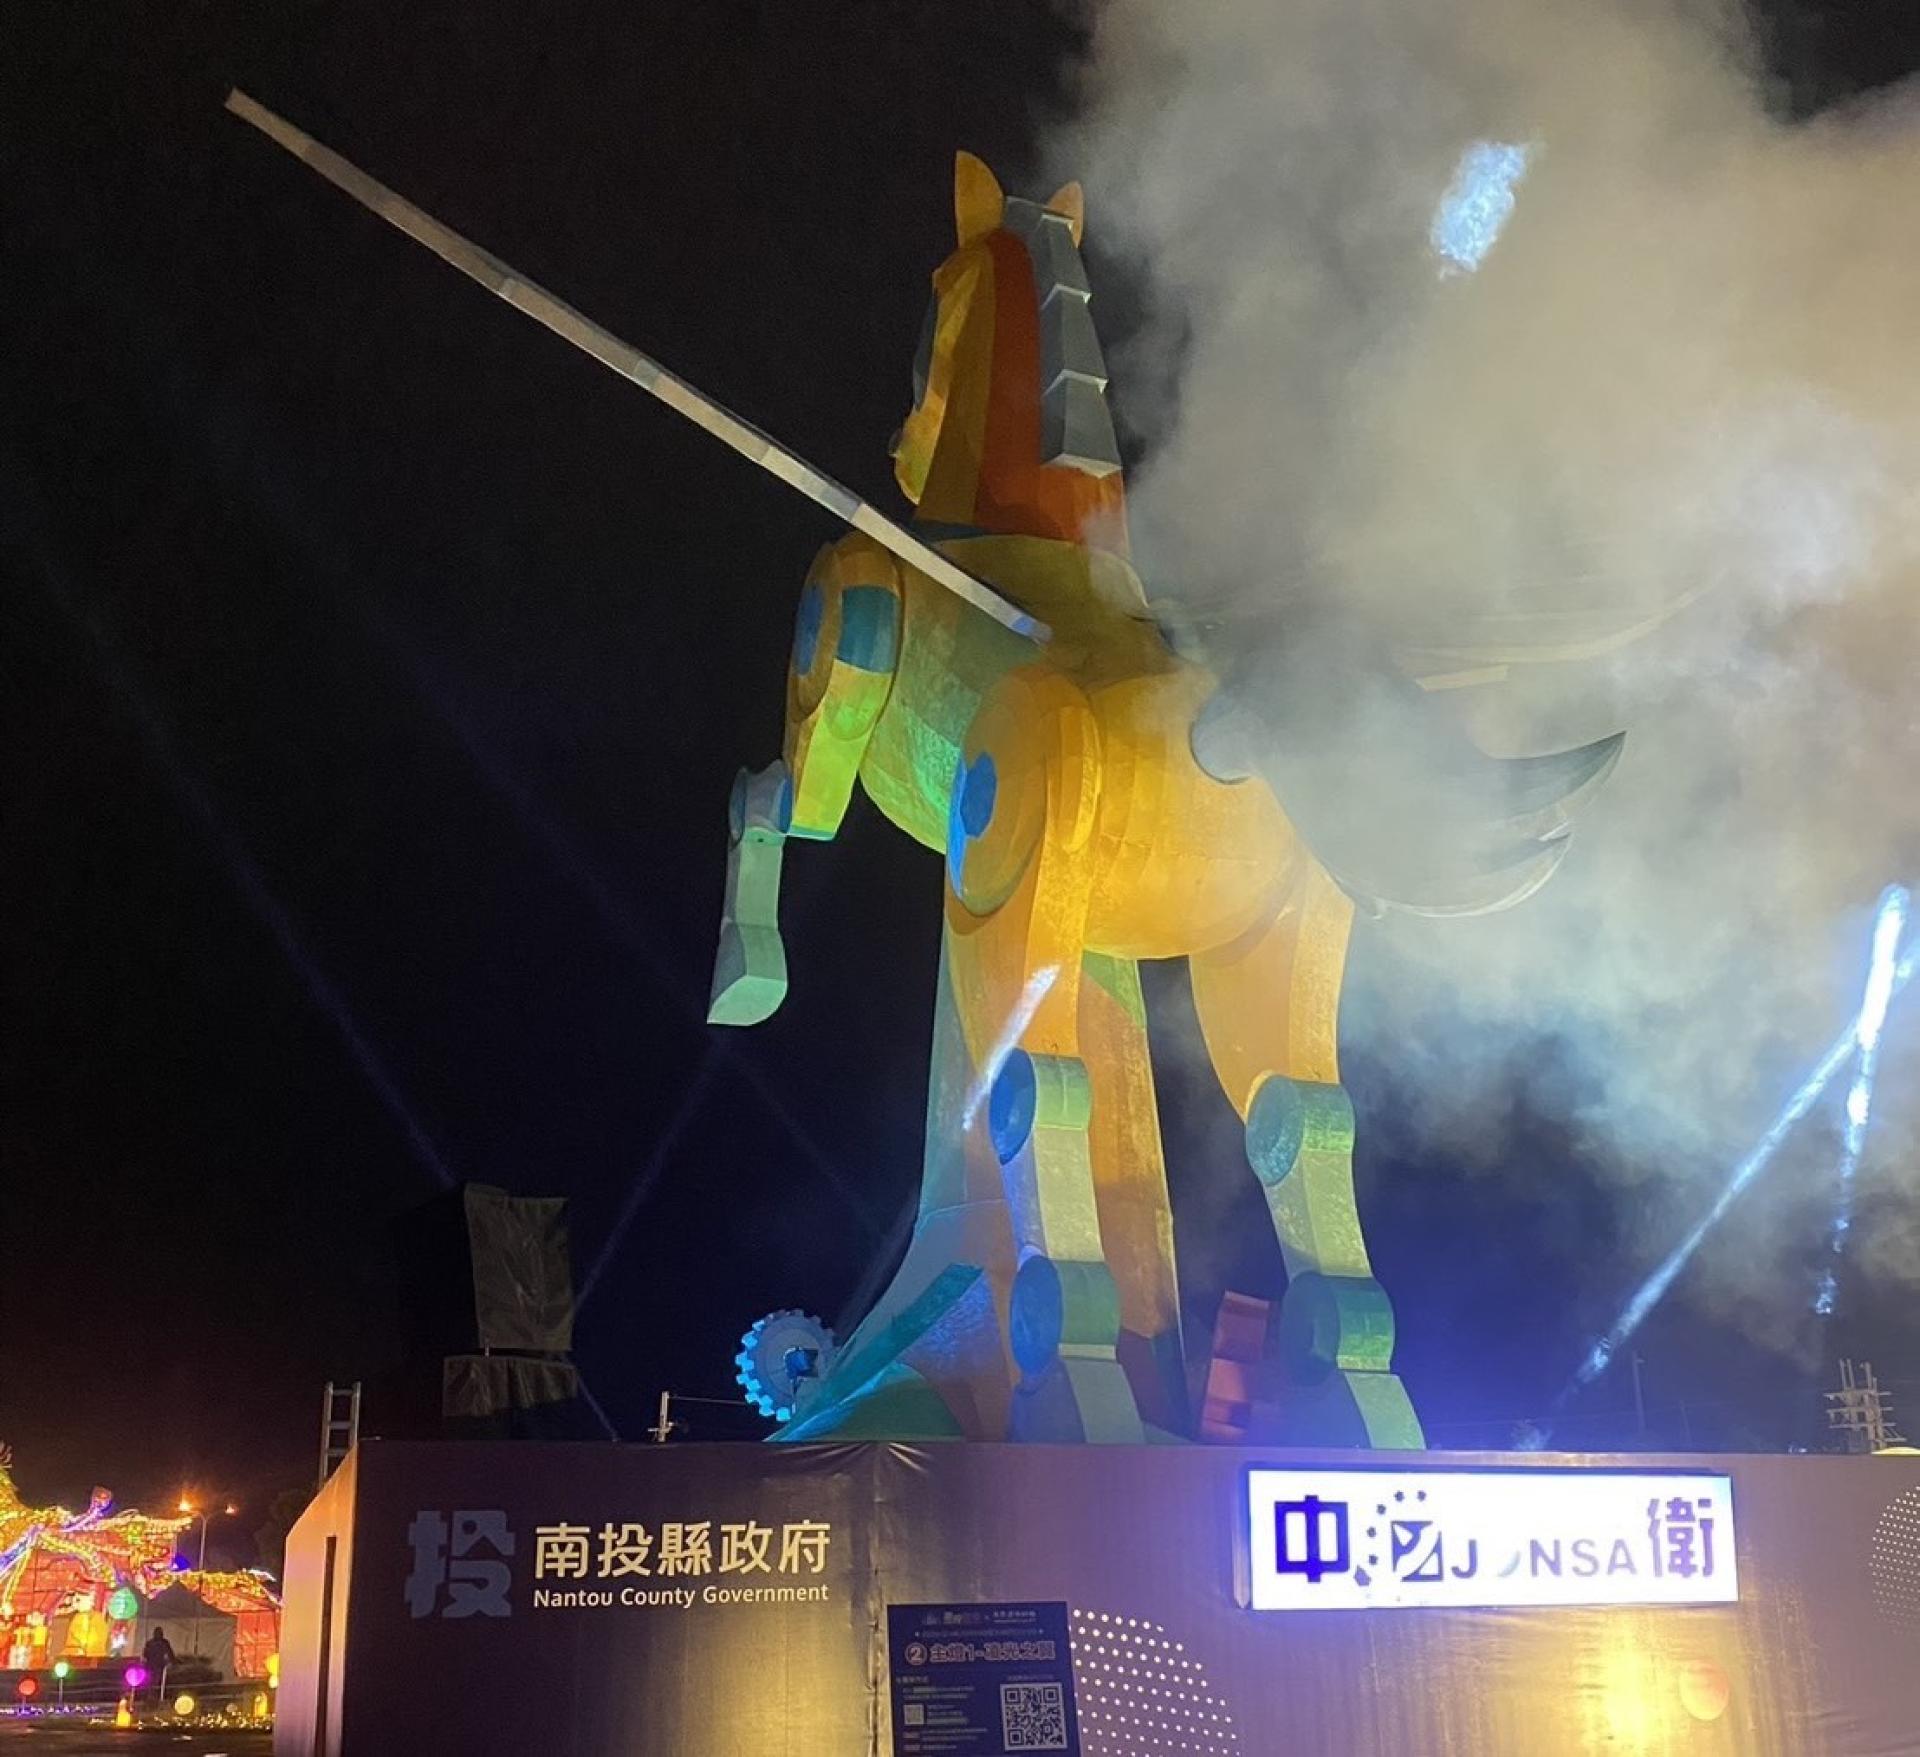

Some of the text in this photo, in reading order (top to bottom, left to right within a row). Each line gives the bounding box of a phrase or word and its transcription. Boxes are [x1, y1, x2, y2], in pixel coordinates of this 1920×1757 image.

[534, 1519, 831, 1579] 南投縣政府
[1275, 1495, 1349, 1582] 中
[1647, 1497, 1714, 1578] 衛
[533, 1584, 829, 1608] Nantou County Government
